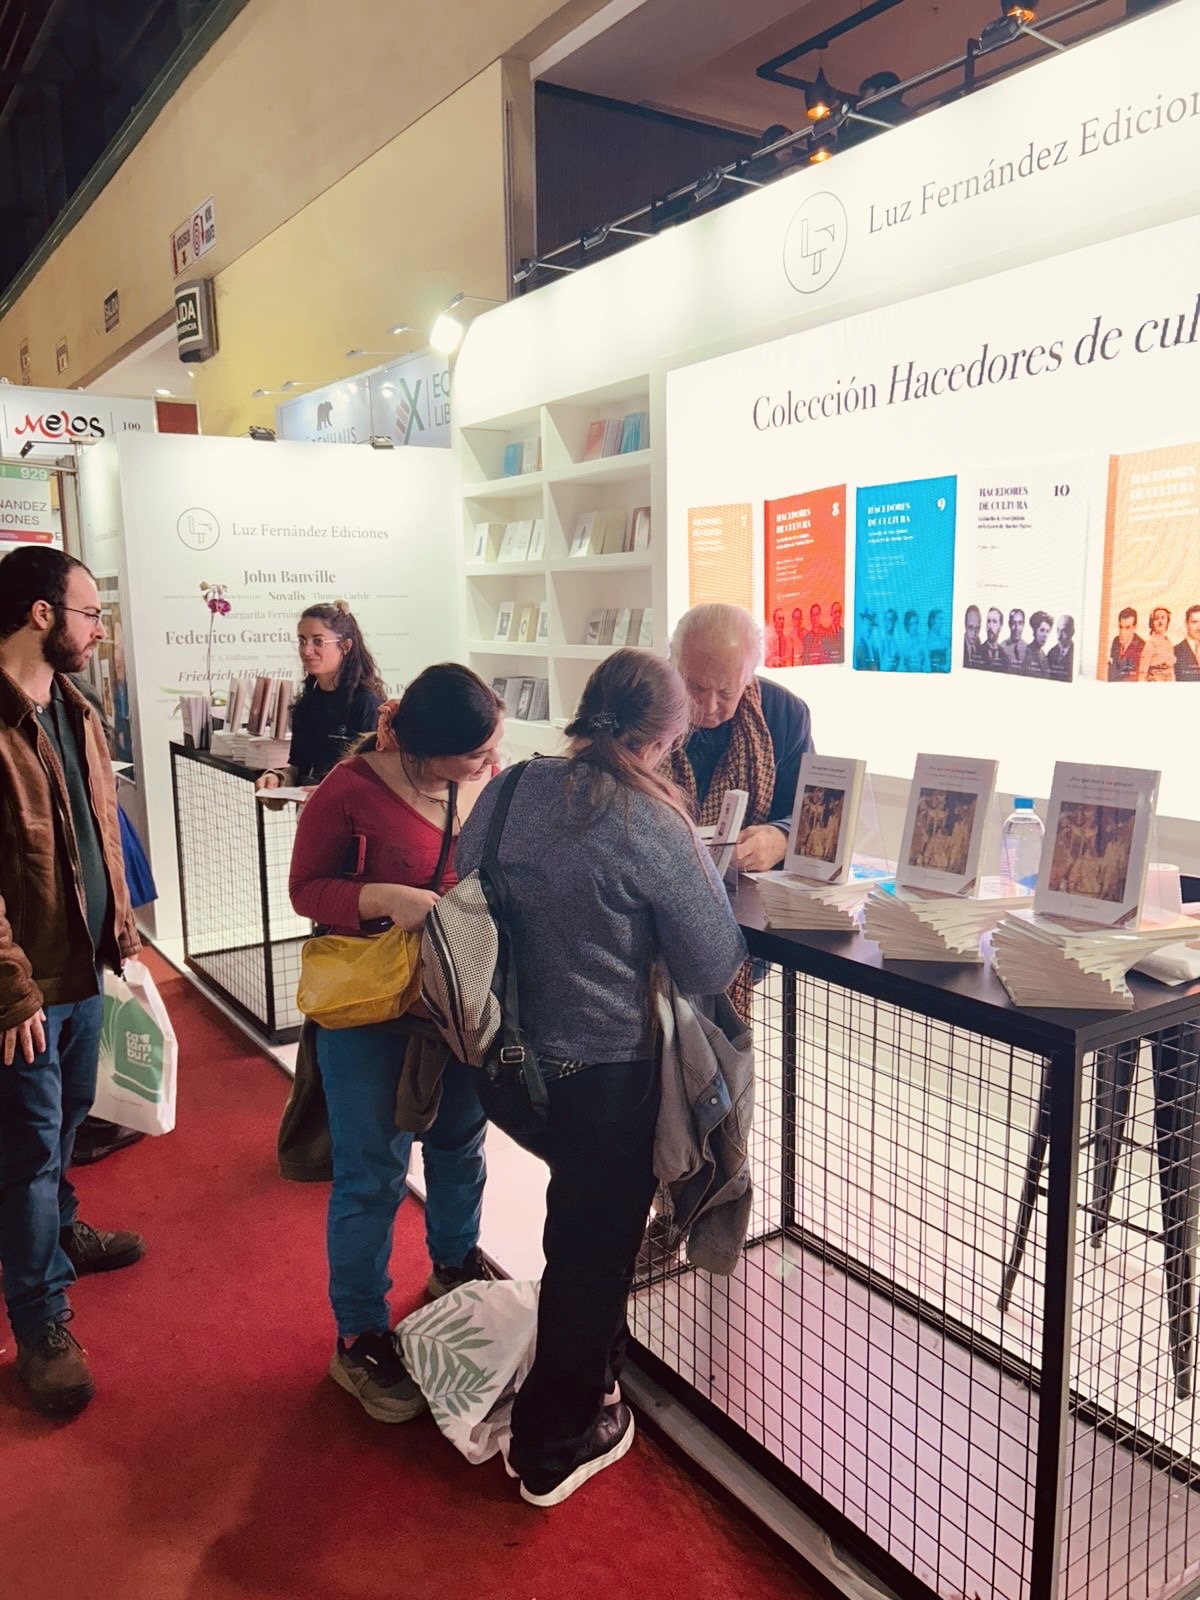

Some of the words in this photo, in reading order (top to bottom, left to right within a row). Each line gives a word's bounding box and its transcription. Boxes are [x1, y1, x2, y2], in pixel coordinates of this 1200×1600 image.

[868, 199, 912, 235] Luz
[920, 139, 1069, 216] Fernández
[752, 375, 878, 432] Colección
[885, 341, 1066, 406] Hacedores
[1073, 314, 1124, 367] de
[1134, 292, 1200, 354] cul
[122, 421, 141, 431] 100
[20, 467, 48, 480] 929
[979, 486, 1029, 498] HACEDORES
[1054, 484, 1070, 497] 10
[832, 501, 840, 517] 8
[936, 497, 947, 511] 9
[978, 501, 990, 512] DE
[991, 500, 1029, 511] CULTURA
[0, 513, 40, 526] IONES
[232, 522, 257, 537] Luz
[261, 523, 328, 538] Fernández
[331, 525, 389, 539] Ediciones
[243, 570, 276, 585] John
[280, 571, 336, 583] Banville
[268, 591, 306, 601] Novalis
[165, 630, 236, 645] Federico
[240, 628, 292, 643] García
[178, 669, 234, 682] Friedrich
